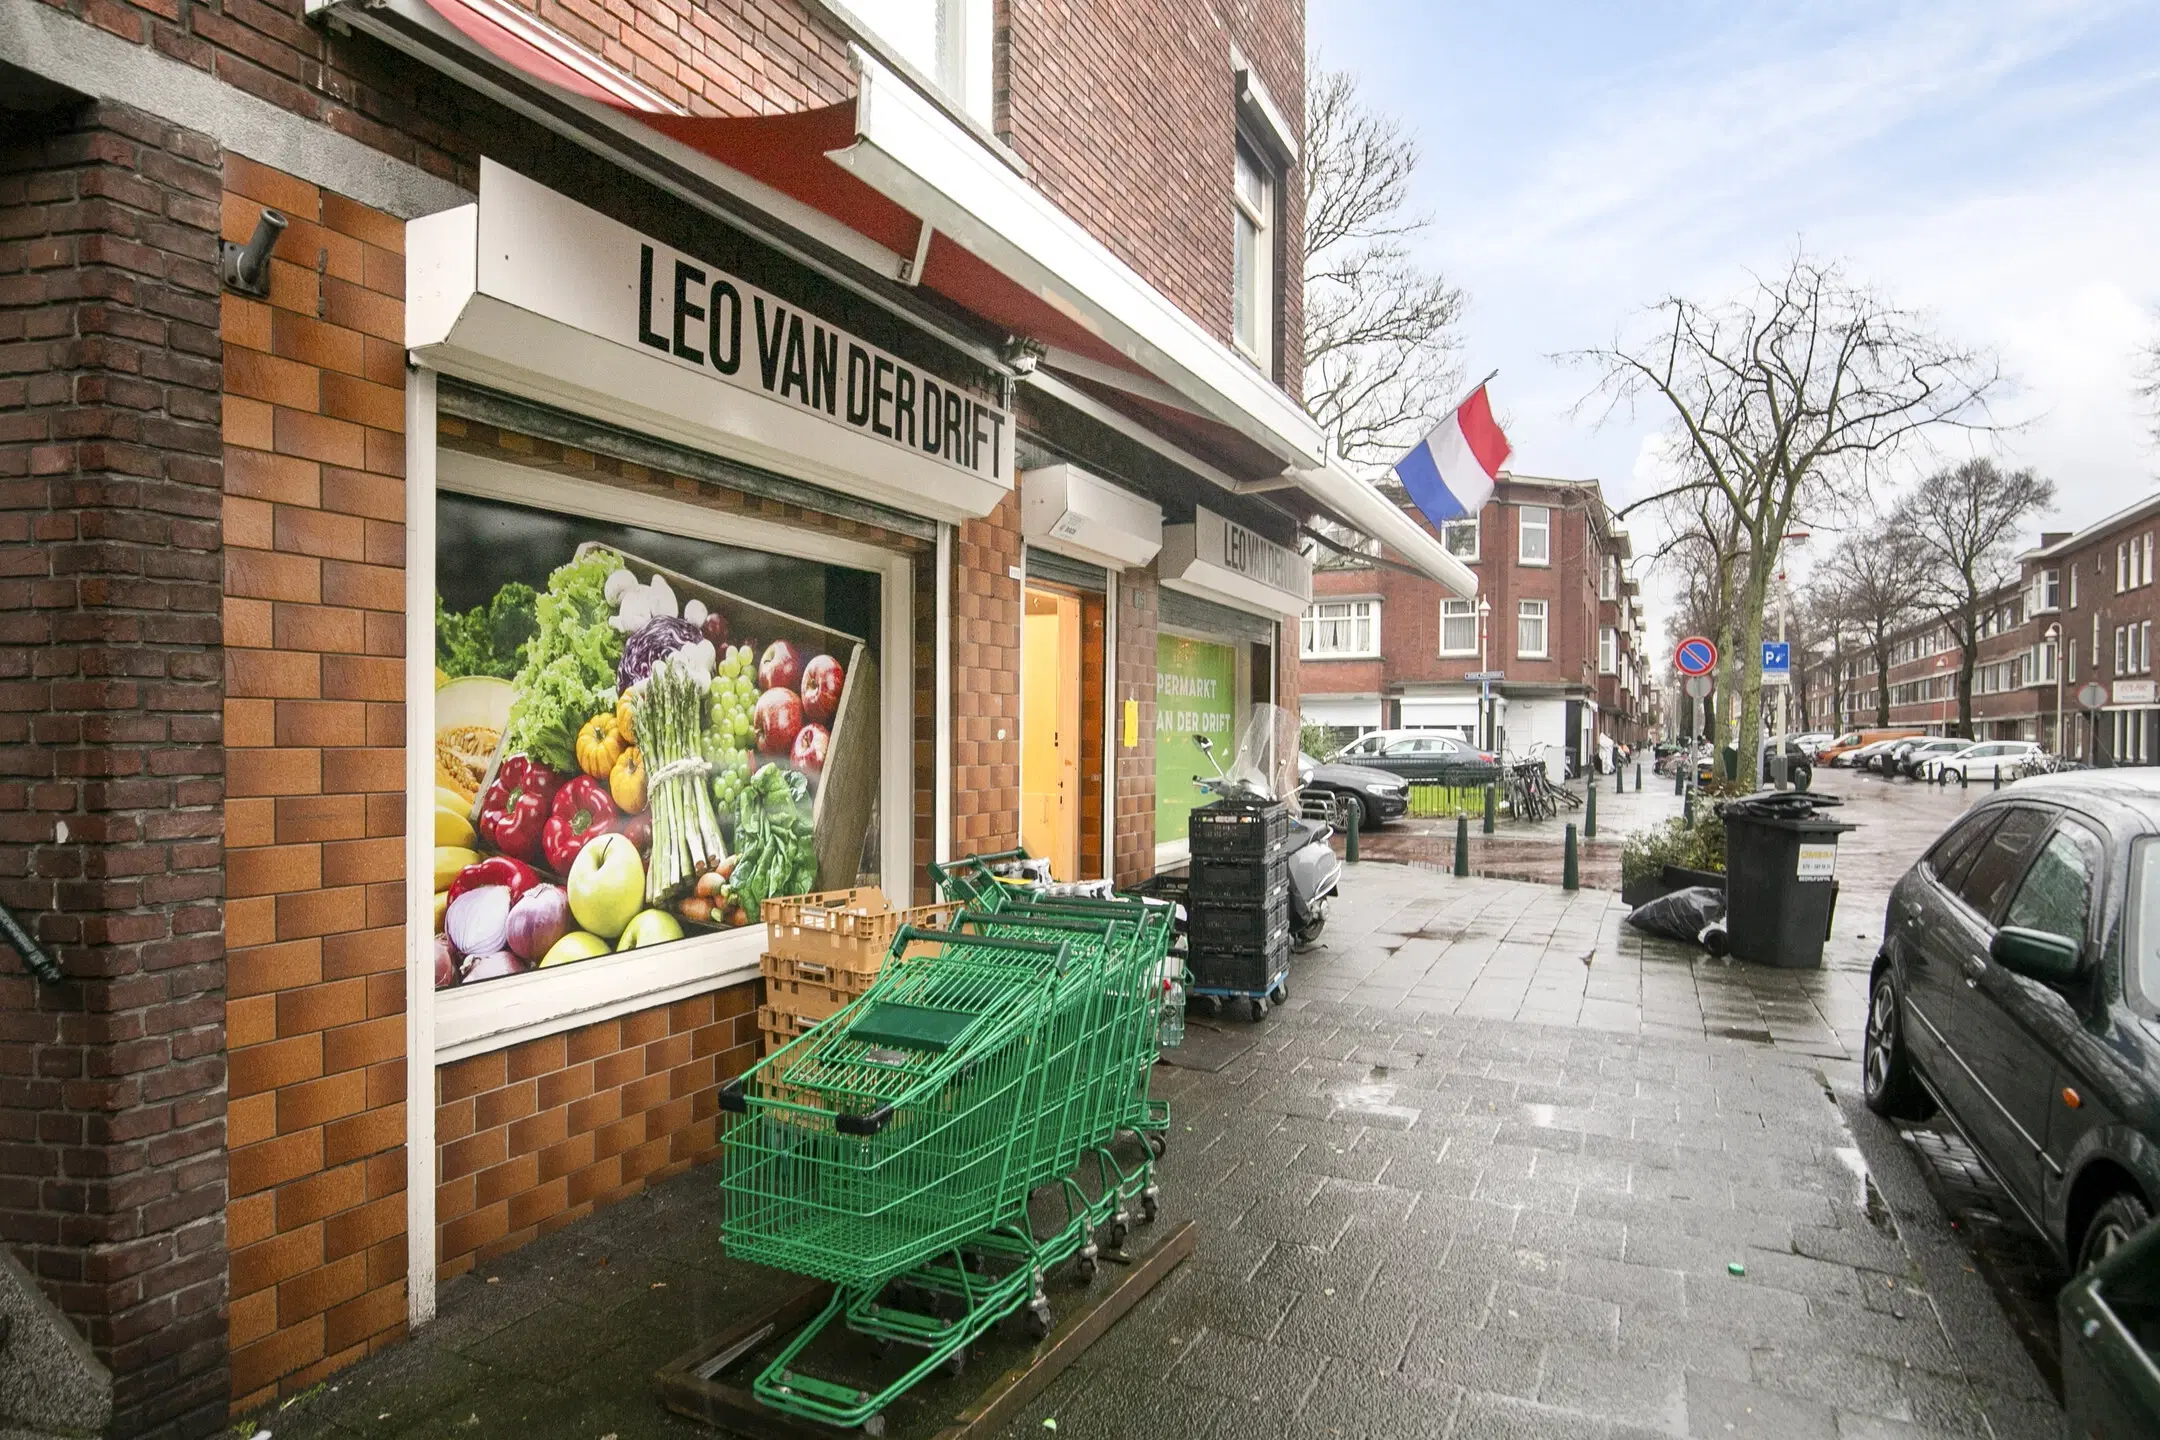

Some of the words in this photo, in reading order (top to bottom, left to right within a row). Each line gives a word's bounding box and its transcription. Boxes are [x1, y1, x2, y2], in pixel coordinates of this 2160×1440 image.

[638, 243, 742, 376] LEO
[753, 295, 839, 416] VAN
[846, 342, 917, 448] DER
[922, 378, 1006, 479] DRIFT
[1224, 521, 1246, 573] LEO
[1247, 533, 1267, 581] VAN
[1765, 651, 1775, 665] P
[1156, 672, 1217, 699] PERMARKT
[1156, 710, 1173, 732] AN
[1177, 711, 1199, 732] DER
[1202, 712, 1231, 732] DRIFT
